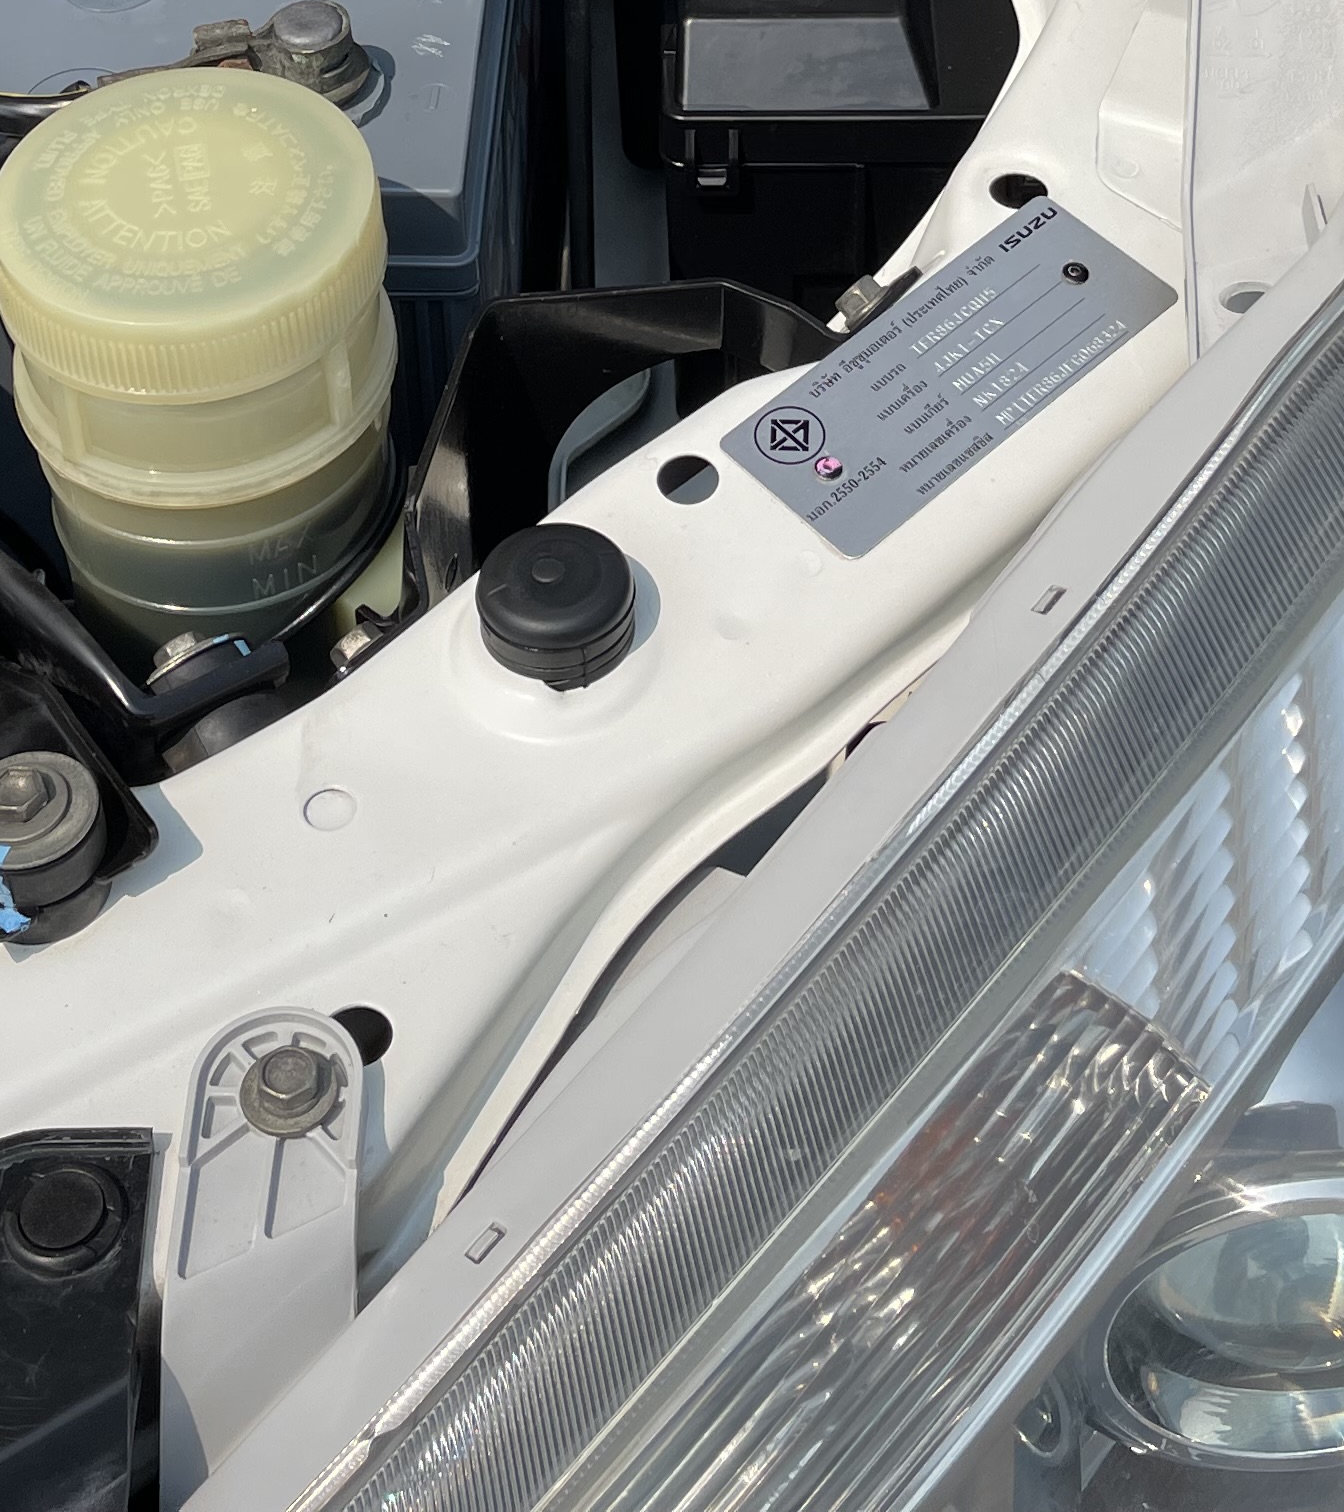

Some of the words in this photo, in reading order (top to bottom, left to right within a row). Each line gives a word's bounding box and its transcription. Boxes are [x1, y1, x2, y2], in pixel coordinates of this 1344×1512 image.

[178, 97, 220, 112] USE
[81, 115, 198, 186] CAUTION
[77, 198, 234, 252] ATTENTION
[997, 206, 1057, 252] ISUZU
[248, 520, 315, 566] MAX
[251, 554, 319, 601] MIN
